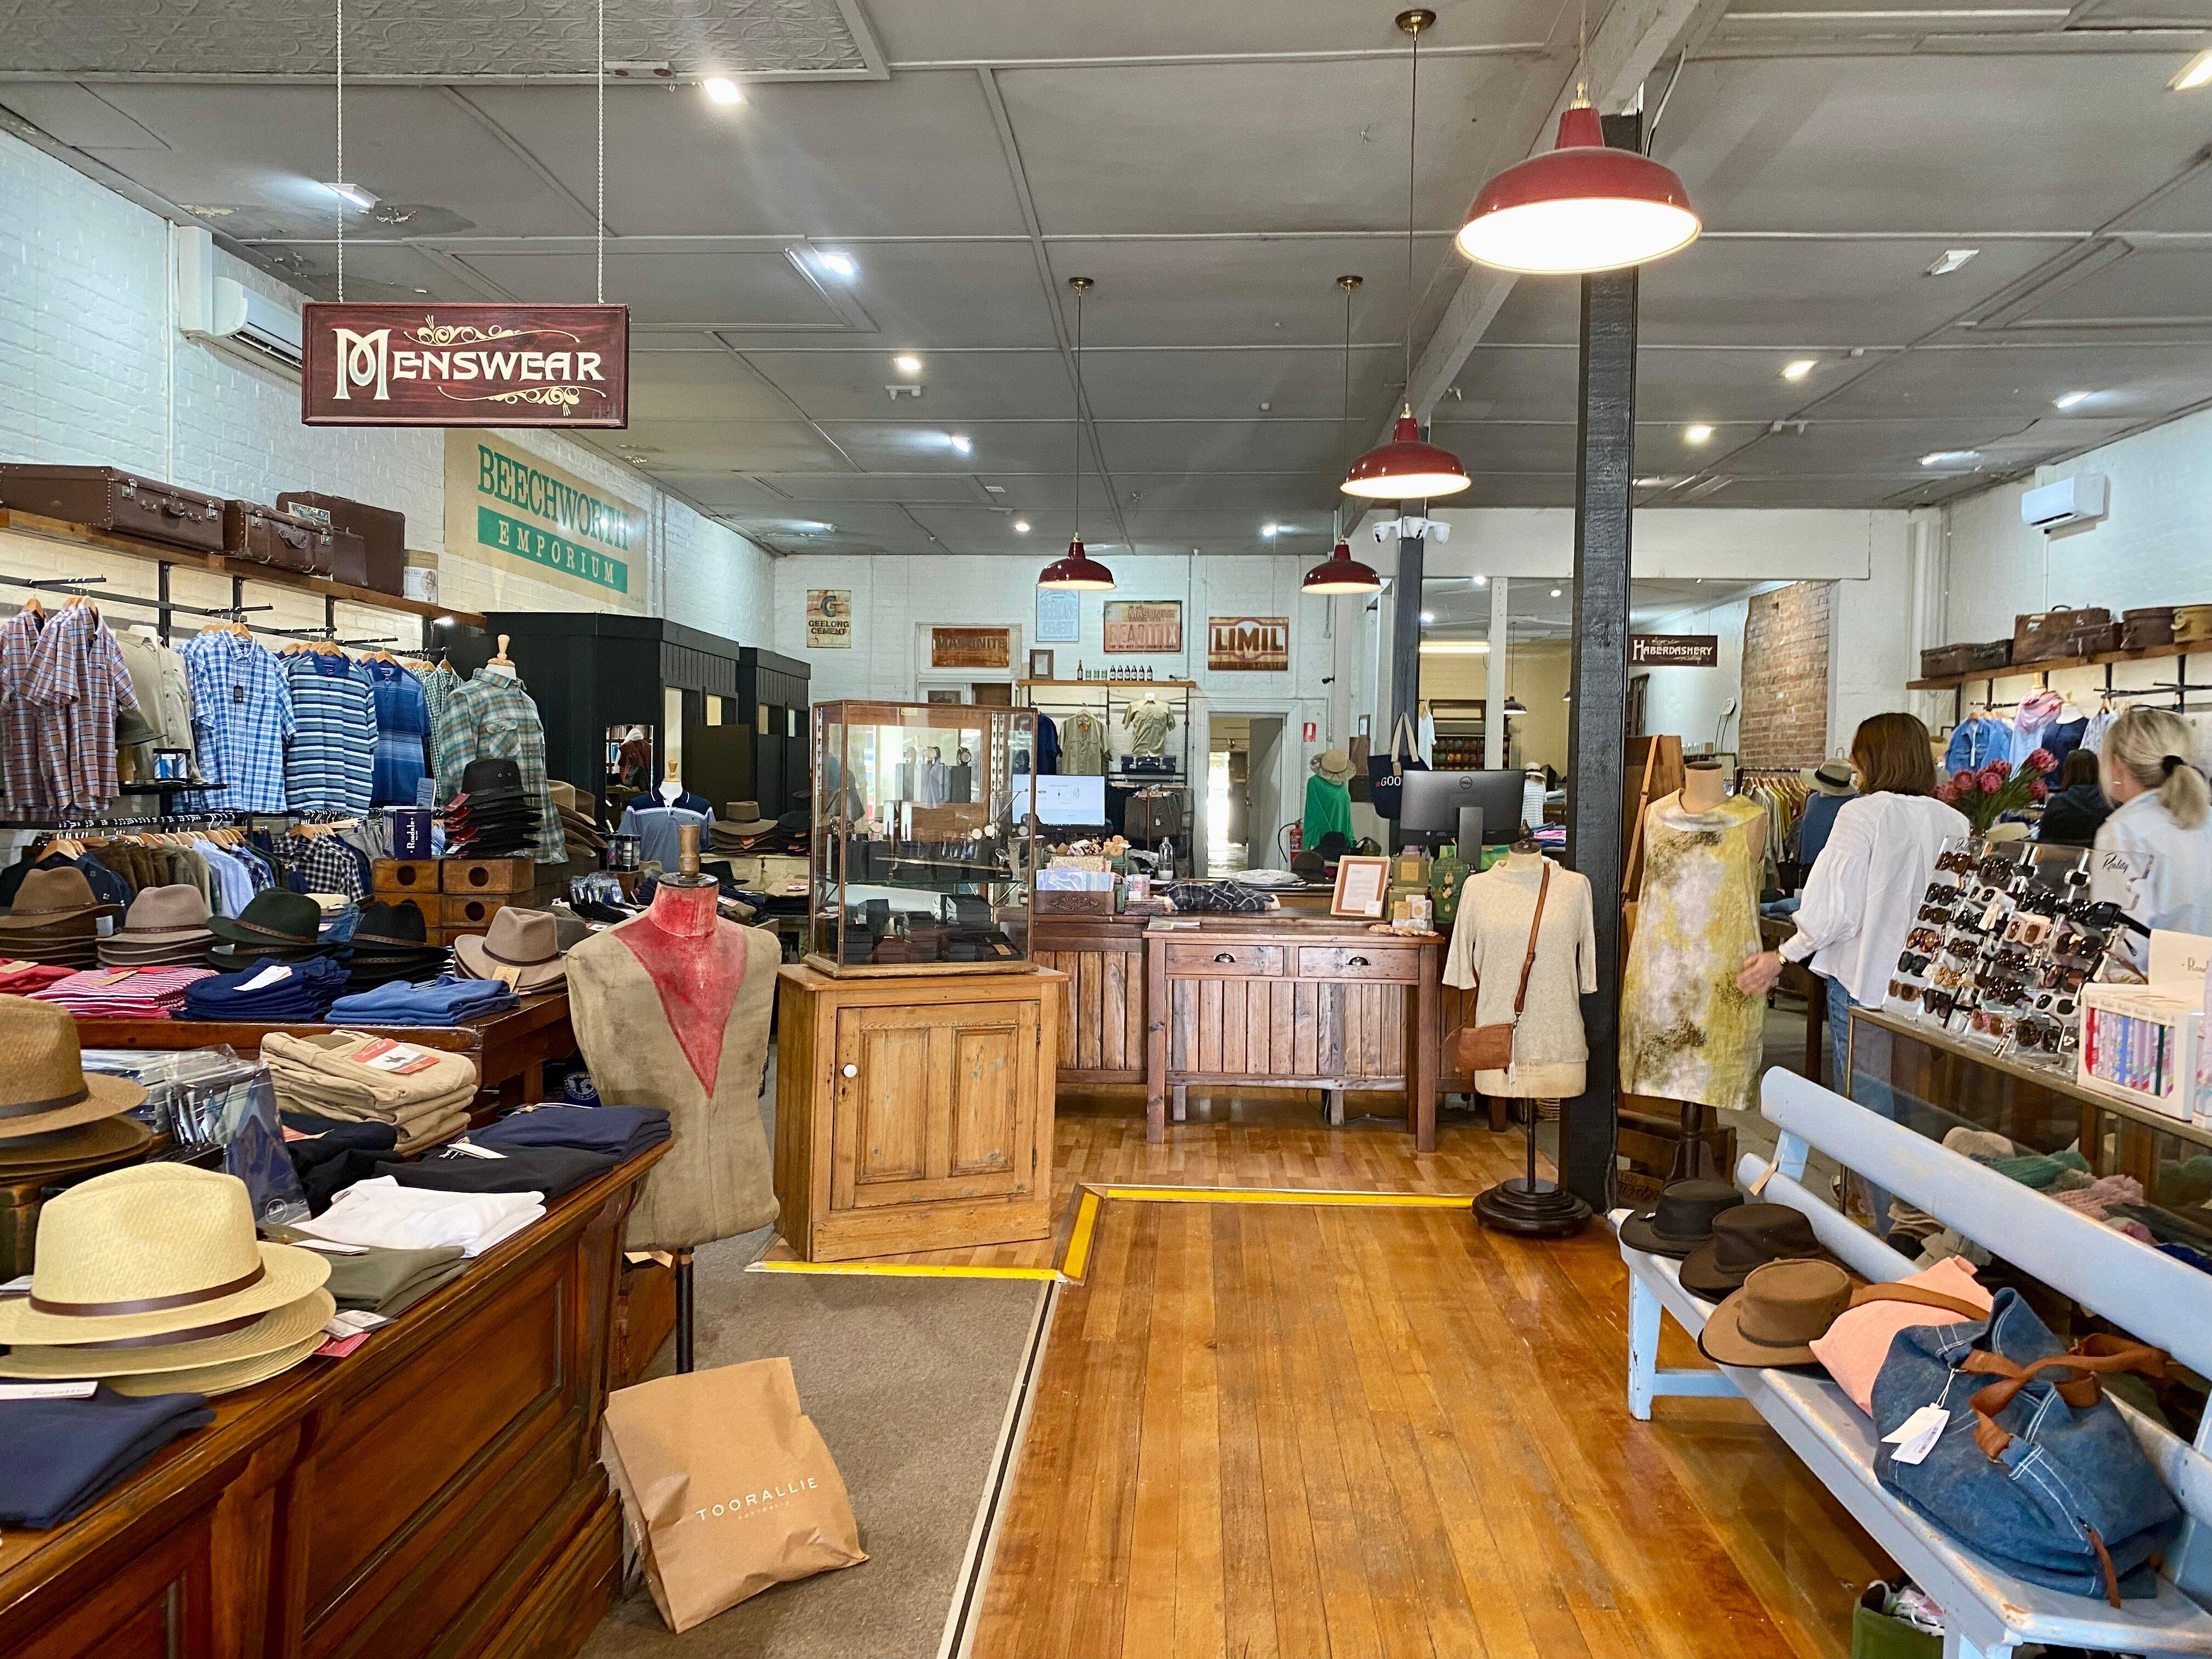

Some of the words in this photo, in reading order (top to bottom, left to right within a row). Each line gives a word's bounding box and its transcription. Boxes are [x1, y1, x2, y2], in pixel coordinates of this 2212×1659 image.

[331, 328, 606, 400] MENSWEAR
[477, 443, 629, 552] BEECHWORTH
[498, 519, 614, 584] EMPORIUM
[1039, 600, 1077, 620] GEELONG
[1127, 610, 1175, 618] MASONITE
[1042, 621, 1074, 635] CEMENT
[1632, 639, 1713, 662] HABERDASHERY
[407, 820, 415, 849] Rosdale
[695, 1476, 818, 1522] TOORALLIE
